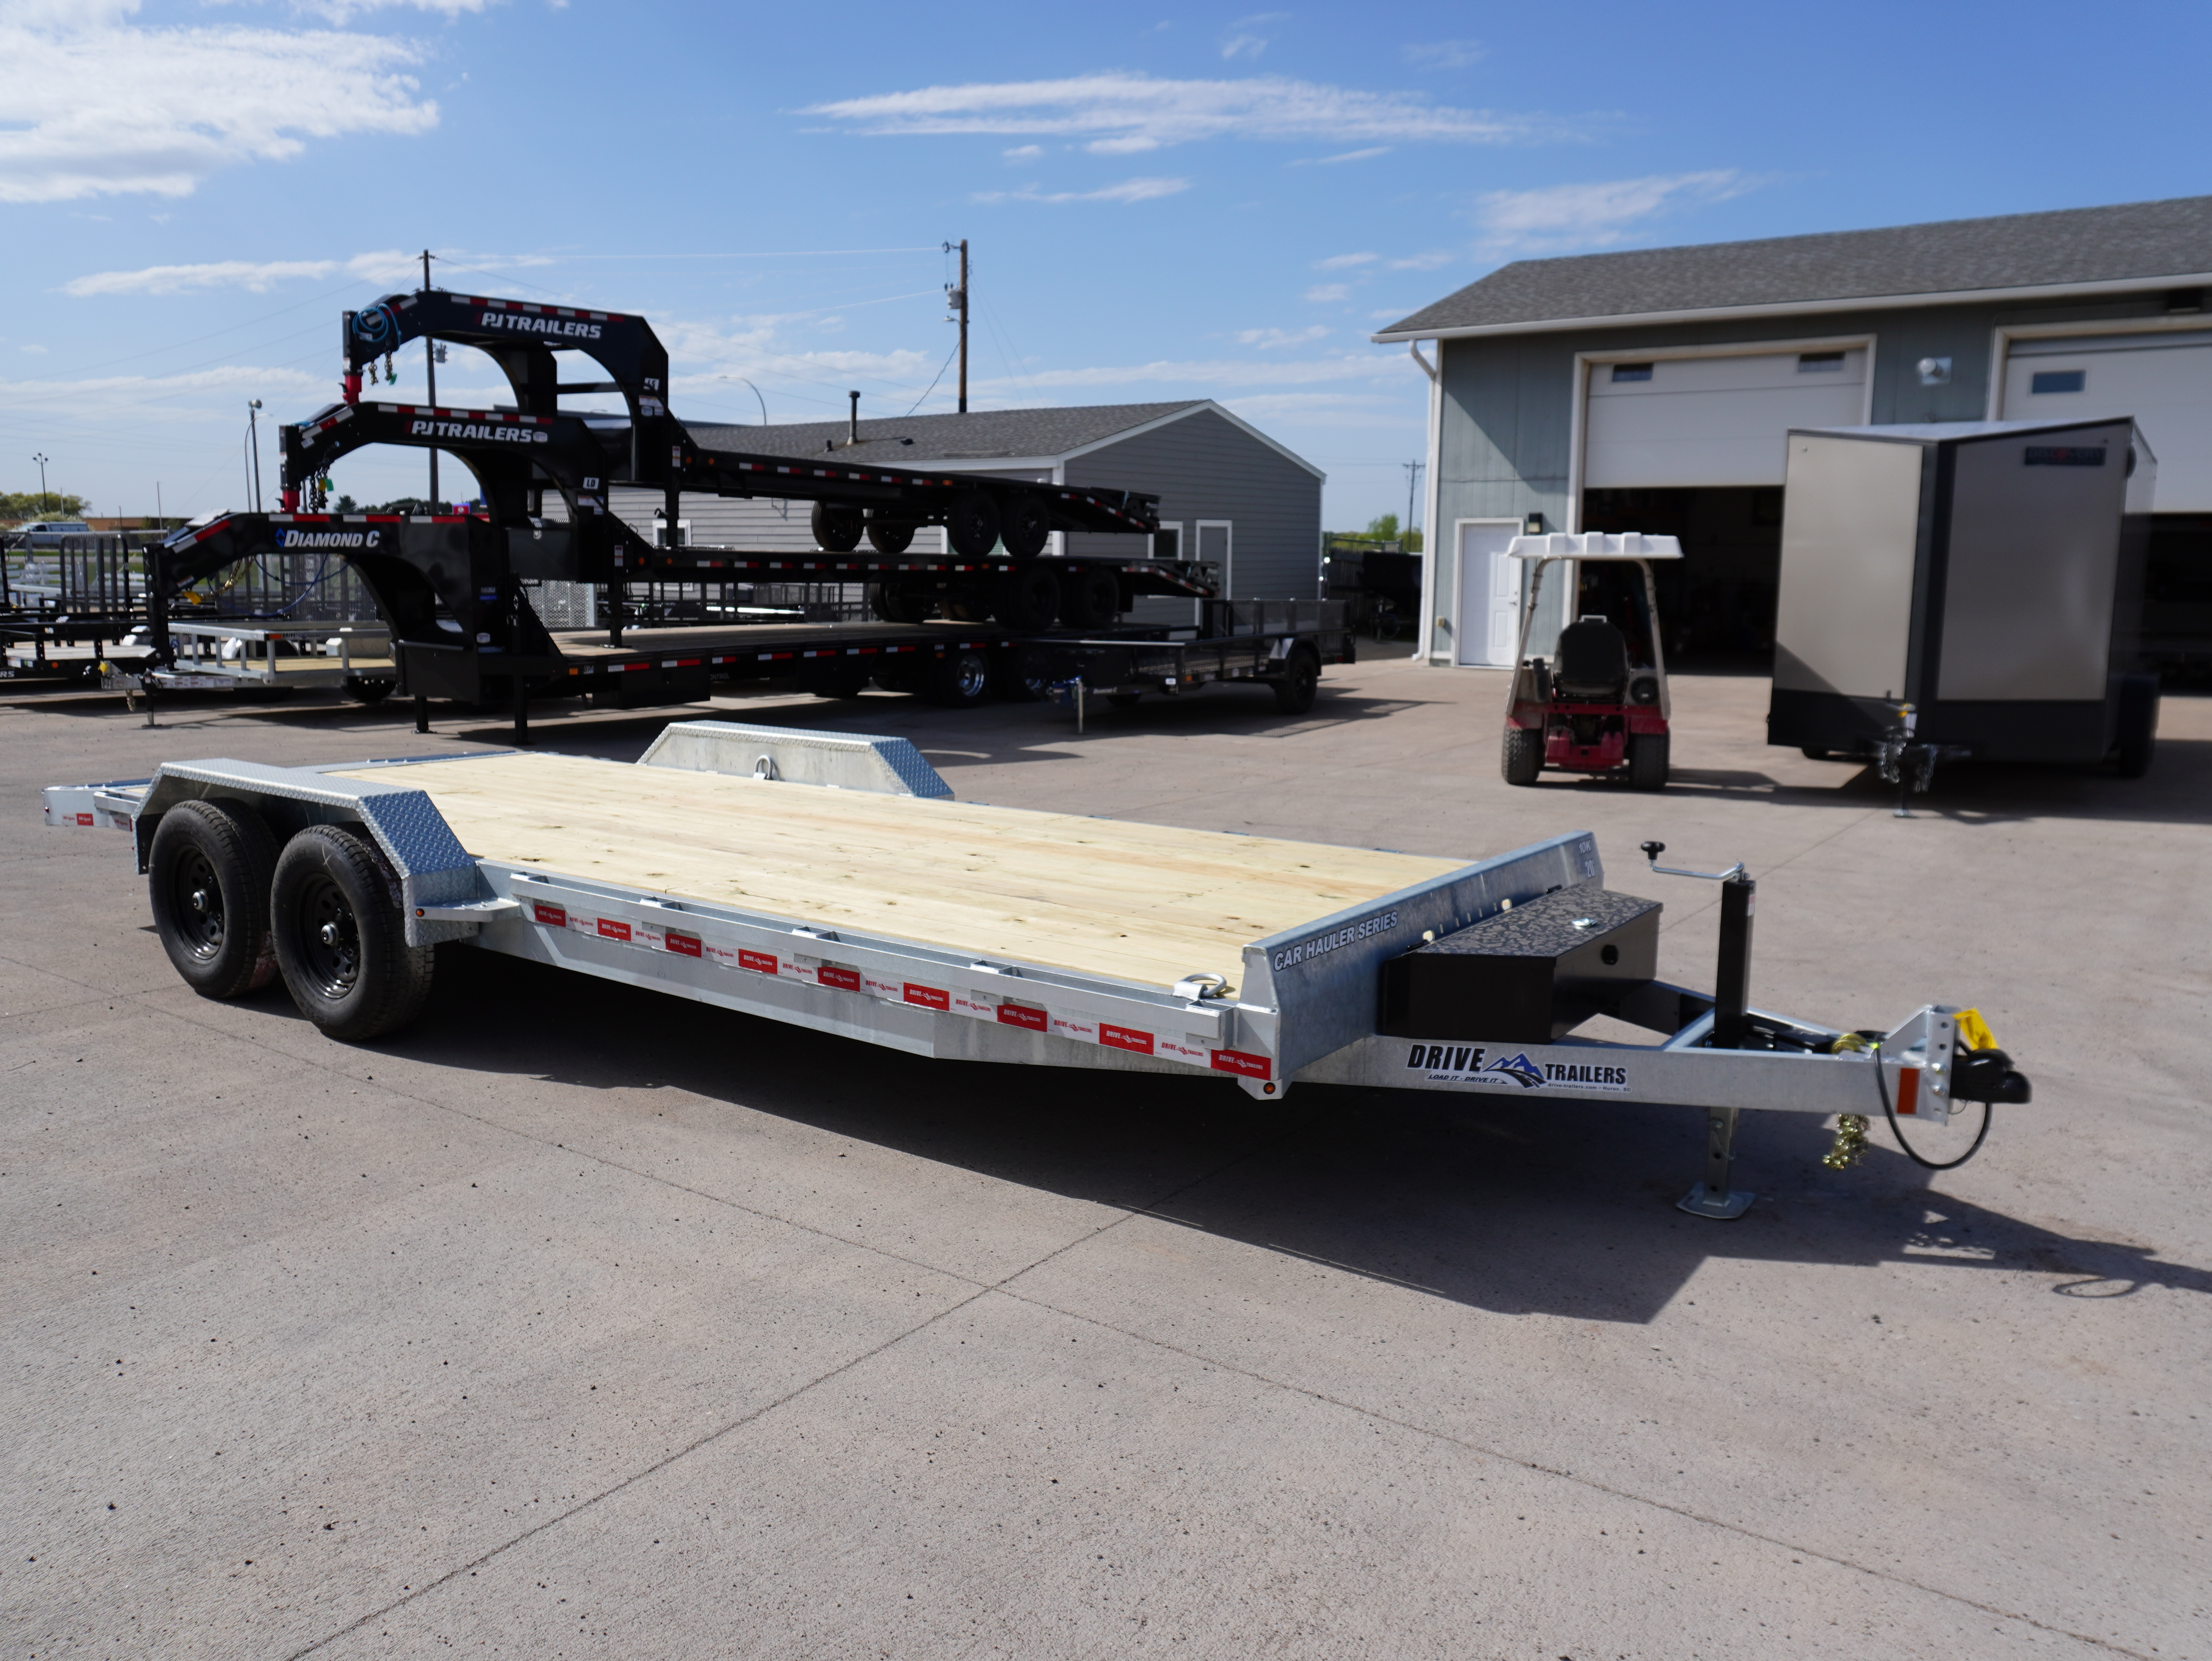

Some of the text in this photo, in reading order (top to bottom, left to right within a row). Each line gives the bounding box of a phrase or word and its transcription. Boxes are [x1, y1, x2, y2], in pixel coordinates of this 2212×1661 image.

[481, 312, 602, 339] PJ TRAILERS
[411, 420, 434, 436] PJ
[436, 421, 533, 443] TRAILERS
[586, 478, 596, 488] LD
[284, 529, 380, 548] DIAMOND C
[1579, 838, 1592, 855] 10K
[1274, 910, 1398, 972] CAR HAULER SERIES
[1003, 1009, 1017, 1017] DRIVE
[1106, 1030, 1121, 1039] DRIVE
[1161, 1042, 1177, 1051] DRIVE
[1219, 1054, 1263, 1070] DRIVE TRAILERS
[1407, 1044, 1486, 1072] DRIVE
[1545, 1063, 1627, 1085] TRAILERS
